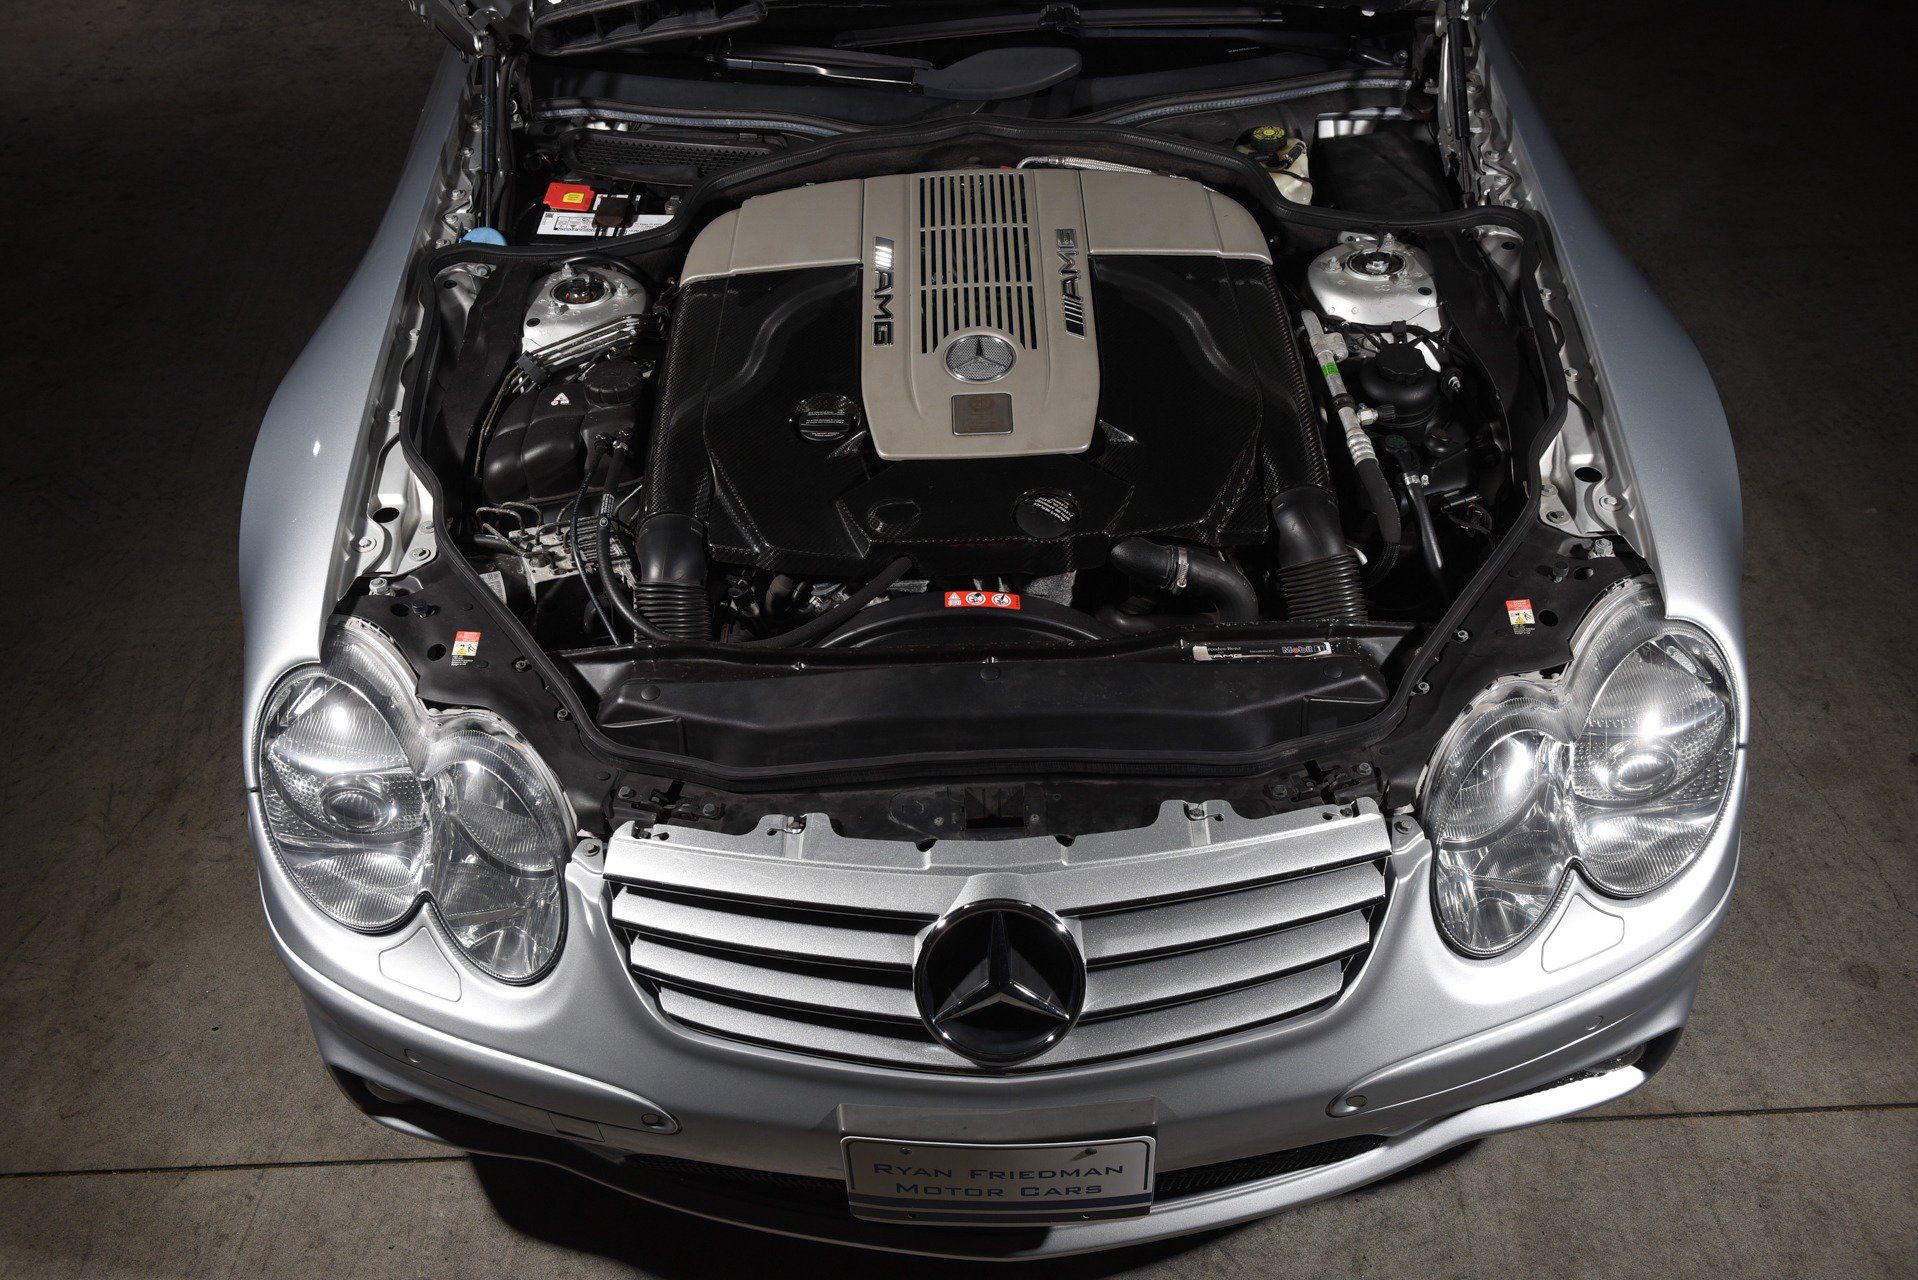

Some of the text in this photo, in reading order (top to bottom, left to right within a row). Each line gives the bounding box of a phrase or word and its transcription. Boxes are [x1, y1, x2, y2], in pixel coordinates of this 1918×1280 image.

[1056, 228, 1081, 300] AMG
[873, 268, 894, 346] AMG
[1282, 646, 1313, 654] Mobil
[873, 1163, 1123, 1180] RYAN FRIEDMAN
[896, 1182, 1102, 1197] MOTOR CARS
